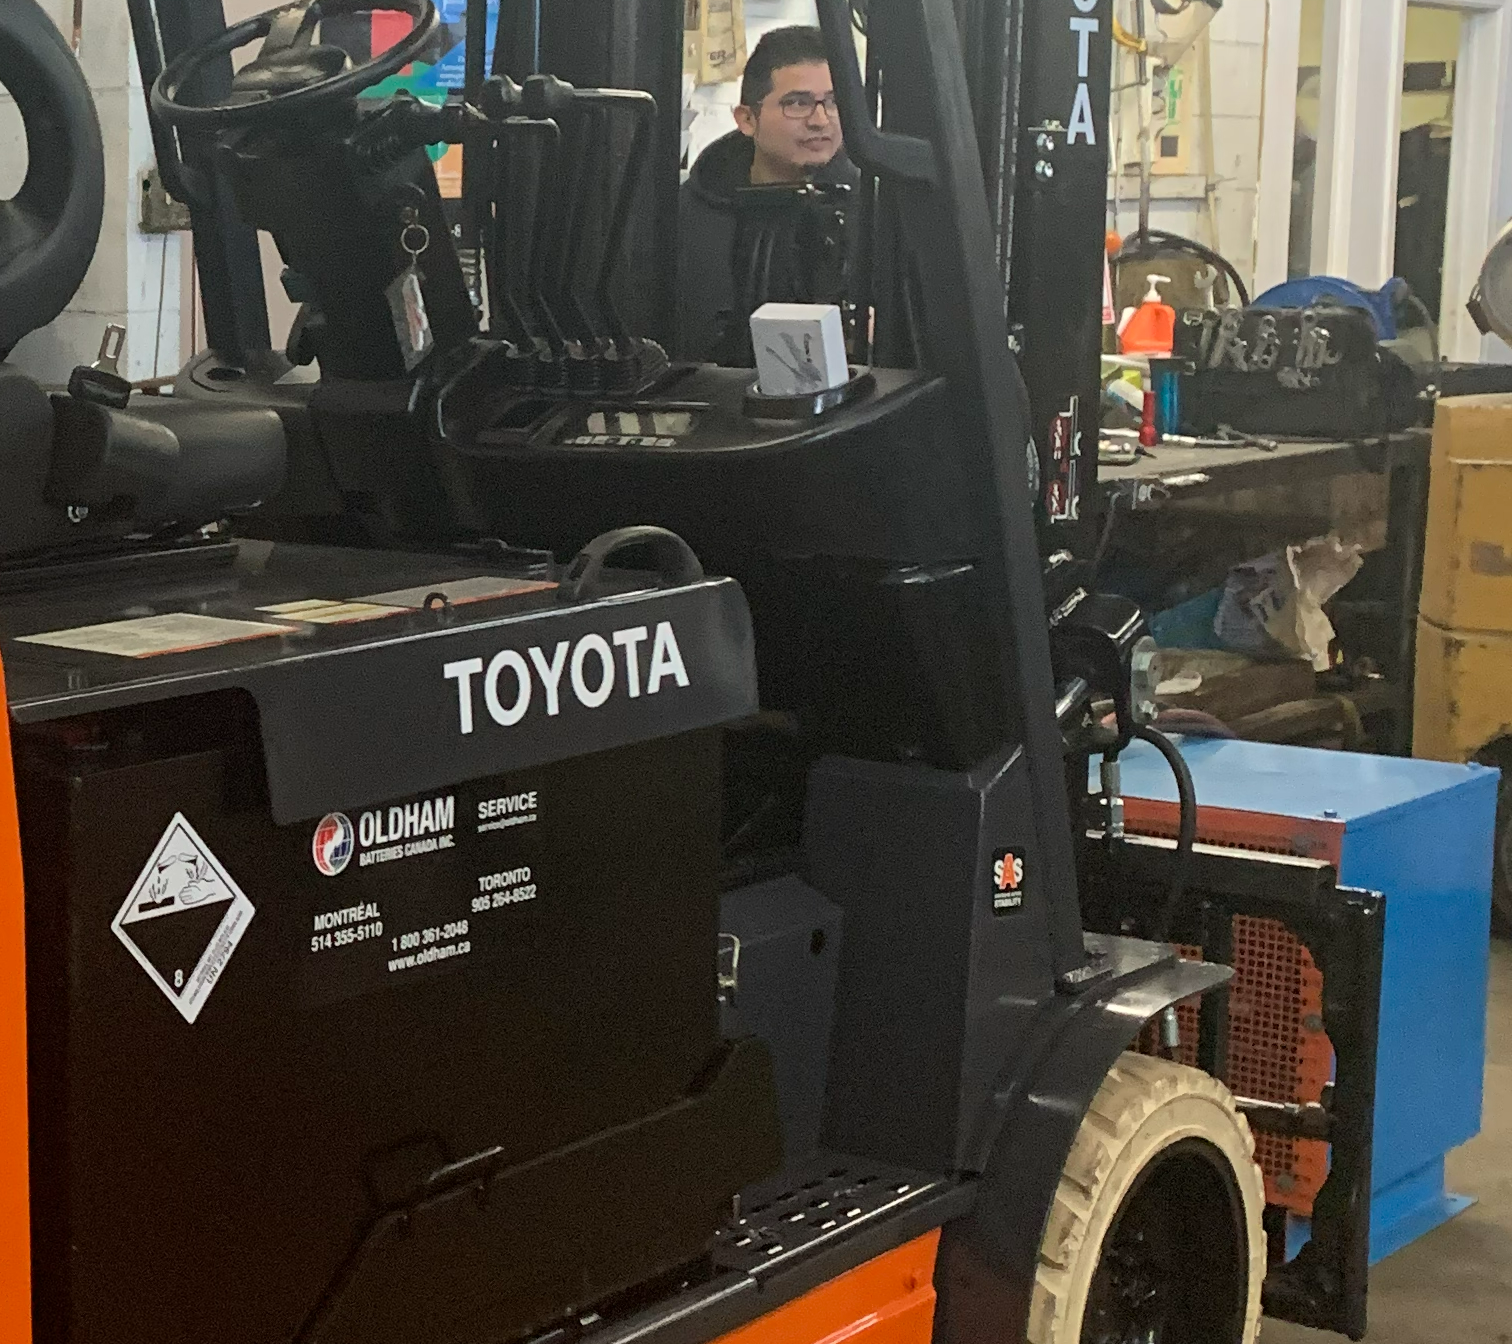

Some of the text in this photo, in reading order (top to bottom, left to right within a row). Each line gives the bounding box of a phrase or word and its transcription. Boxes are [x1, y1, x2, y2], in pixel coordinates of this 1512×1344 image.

[443, 621, 690, 735] TOYOTA
[359, 795, 455, 847] OLDHAM
[478, 791, 538, 819] SERVICE
[359, 834, 456, 867] BATTERIES CANADA INC.
[478, 866, 531, 892] TORONTO
[994, 853, 1023, 890] SAS
[314, 900, 380, 931] MONTRÉAL
[311, 921, 383, 952] 514 355-5110
[391, 919, 469, 952] 1 800 361-2048
[388, 941, 471, 972] www.oldham.ca
